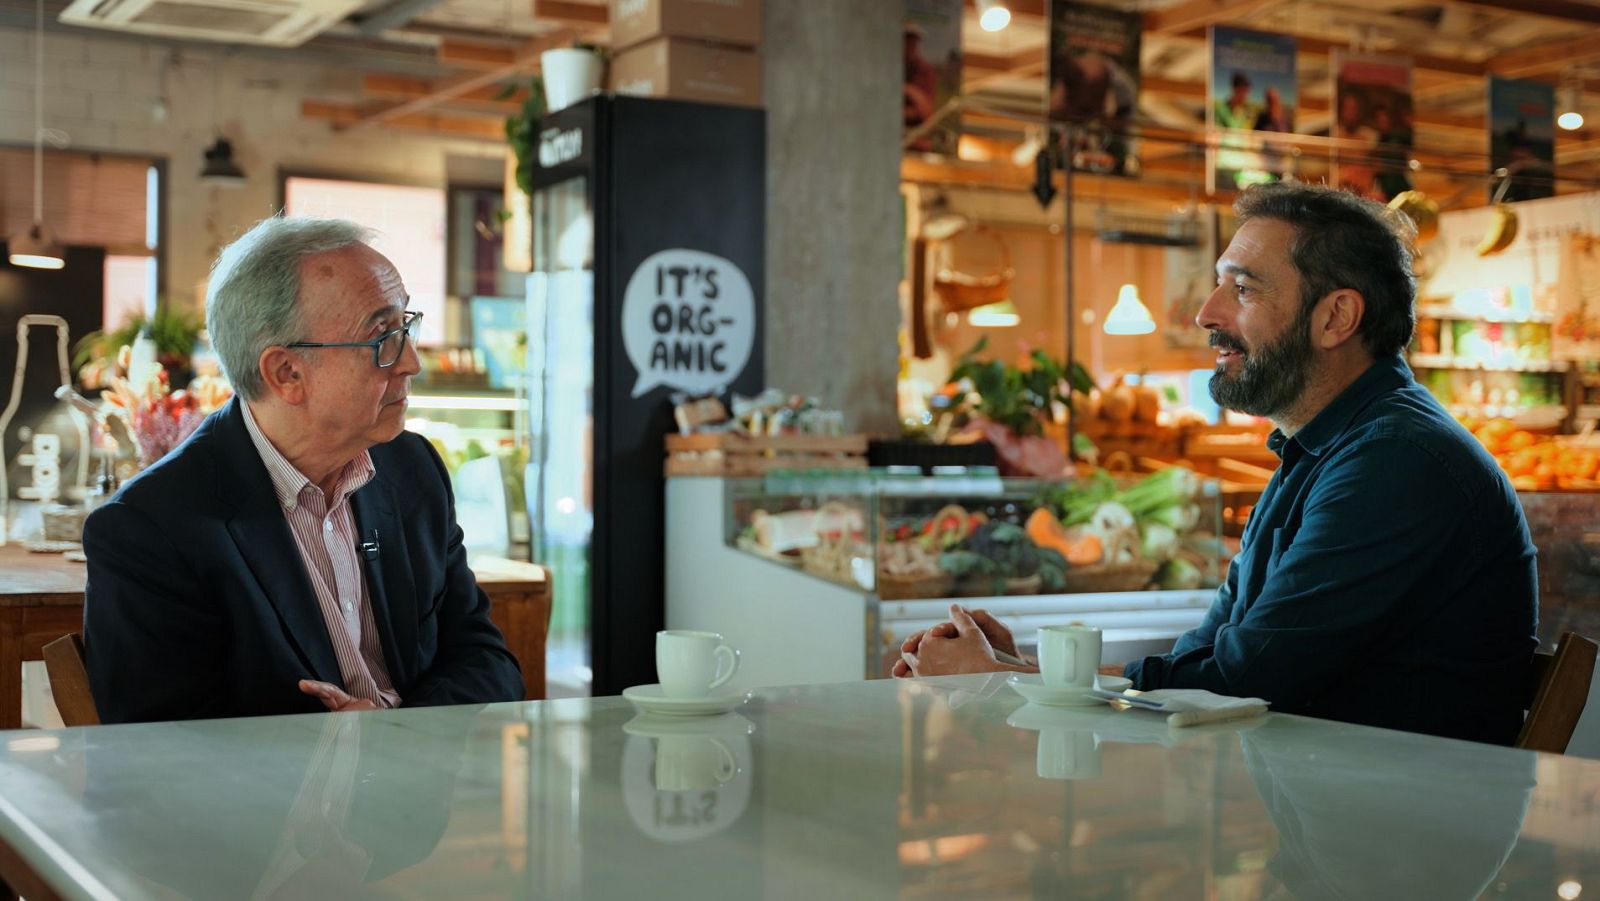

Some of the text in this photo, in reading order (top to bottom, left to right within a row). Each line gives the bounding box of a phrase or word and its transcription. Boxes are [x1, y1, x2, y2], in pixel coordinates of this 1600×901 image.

[655, 265, 720, 299] IT'S
[652, 302, 735, 335] ORG-
[650, 341, 727, 372] ANIC
